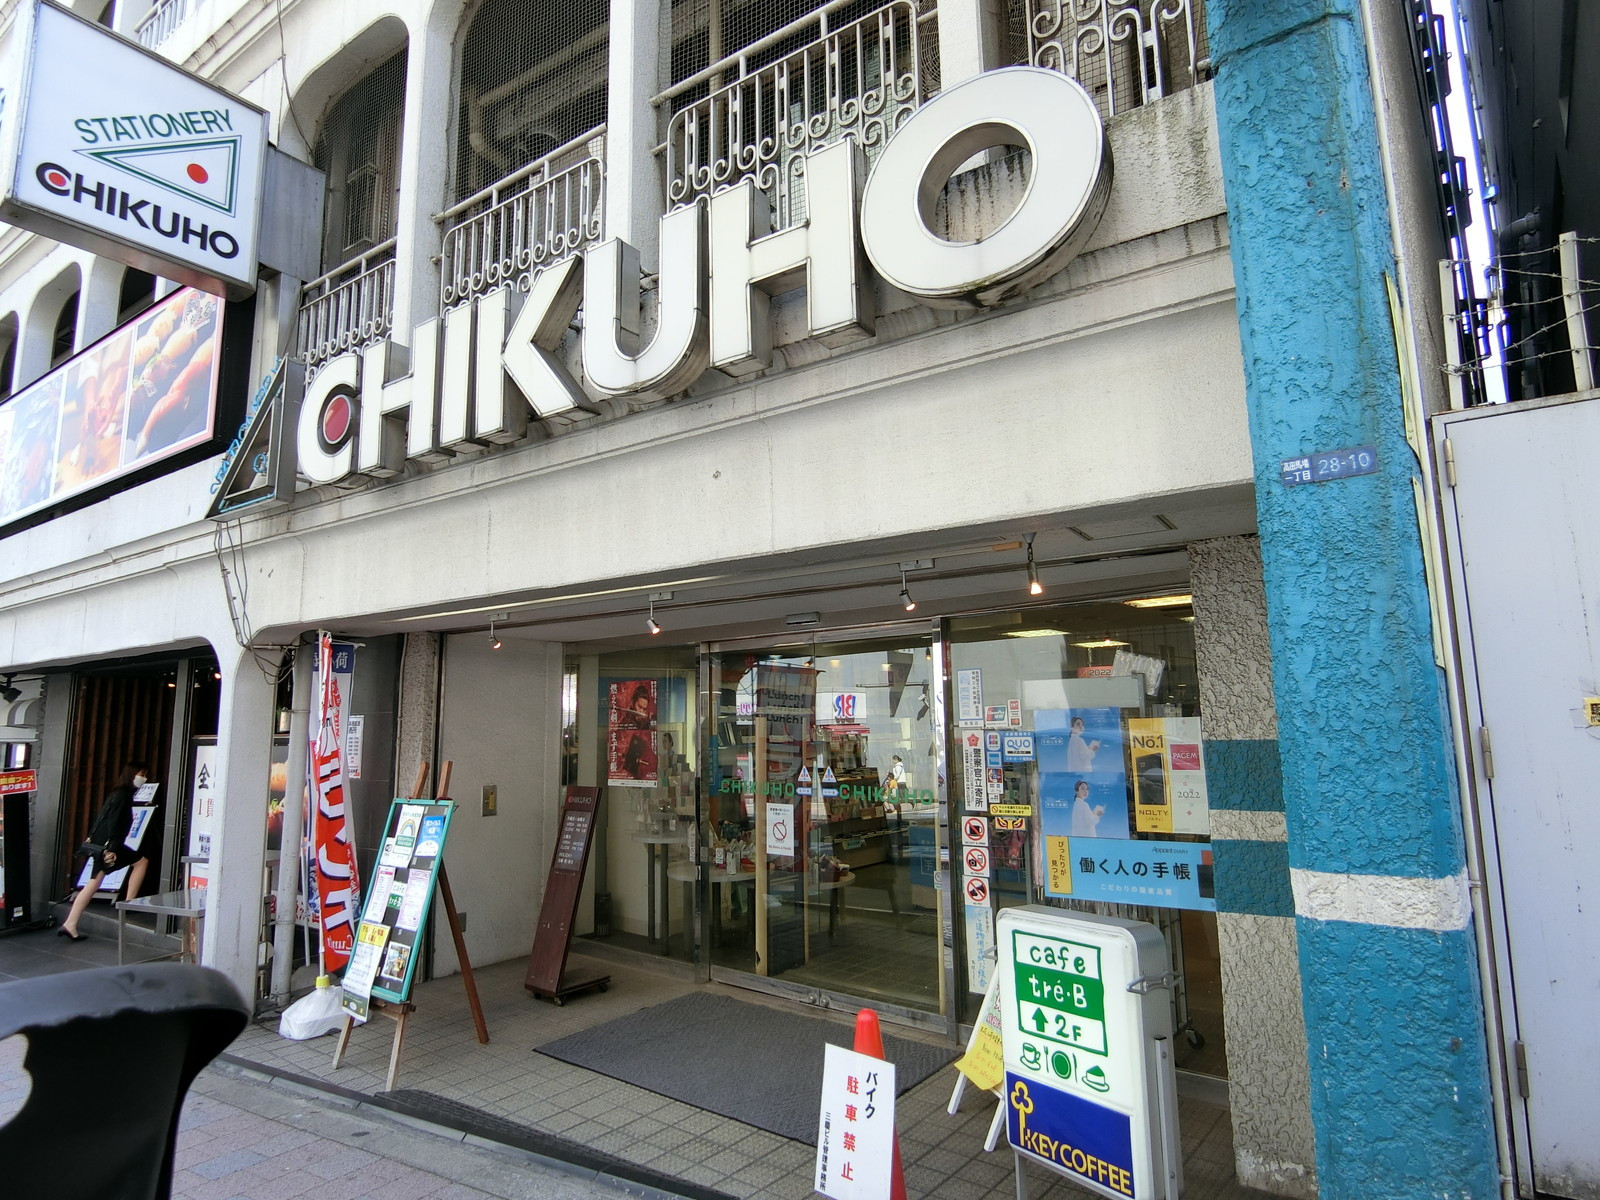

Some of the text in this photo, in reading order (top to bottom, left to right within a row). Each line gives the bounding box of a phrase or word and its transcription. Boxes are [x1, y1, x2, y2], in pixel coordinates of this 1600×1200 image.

[74, 108, 234, 145] STATIONERY
[35, 161, 240, 260] CHIKUHO
[297, 66, 1111, 487] CHIKUHO
[1284, 470, 1311, 482] 一丁目
[1319, 452, 1370, 475] 28-10
[1007, 739, 1031, 750] QUO
[1132, 735, 1164, 749] No.1
[719, 779, 795, 797] CHIKUHO
[973, 748, 983, 808] 警察官立寄所
[839, 784, 934, 805] CHIKUHO
[1177, 791, 1201, 799] 2022
[1058, 841, 1067, 876] ぴったりが
[1079, 857, 1191, 880] 働く人の手帳
[1051, 860, 1059, 889] 見つかる
[1029, 945, 1086, 975] cafe
[1055, 1014, 1082, 1042] 2F
[864, 1072, 879, 1119] バイク
[841, 1075, 859, 1181] 駐車禁止
